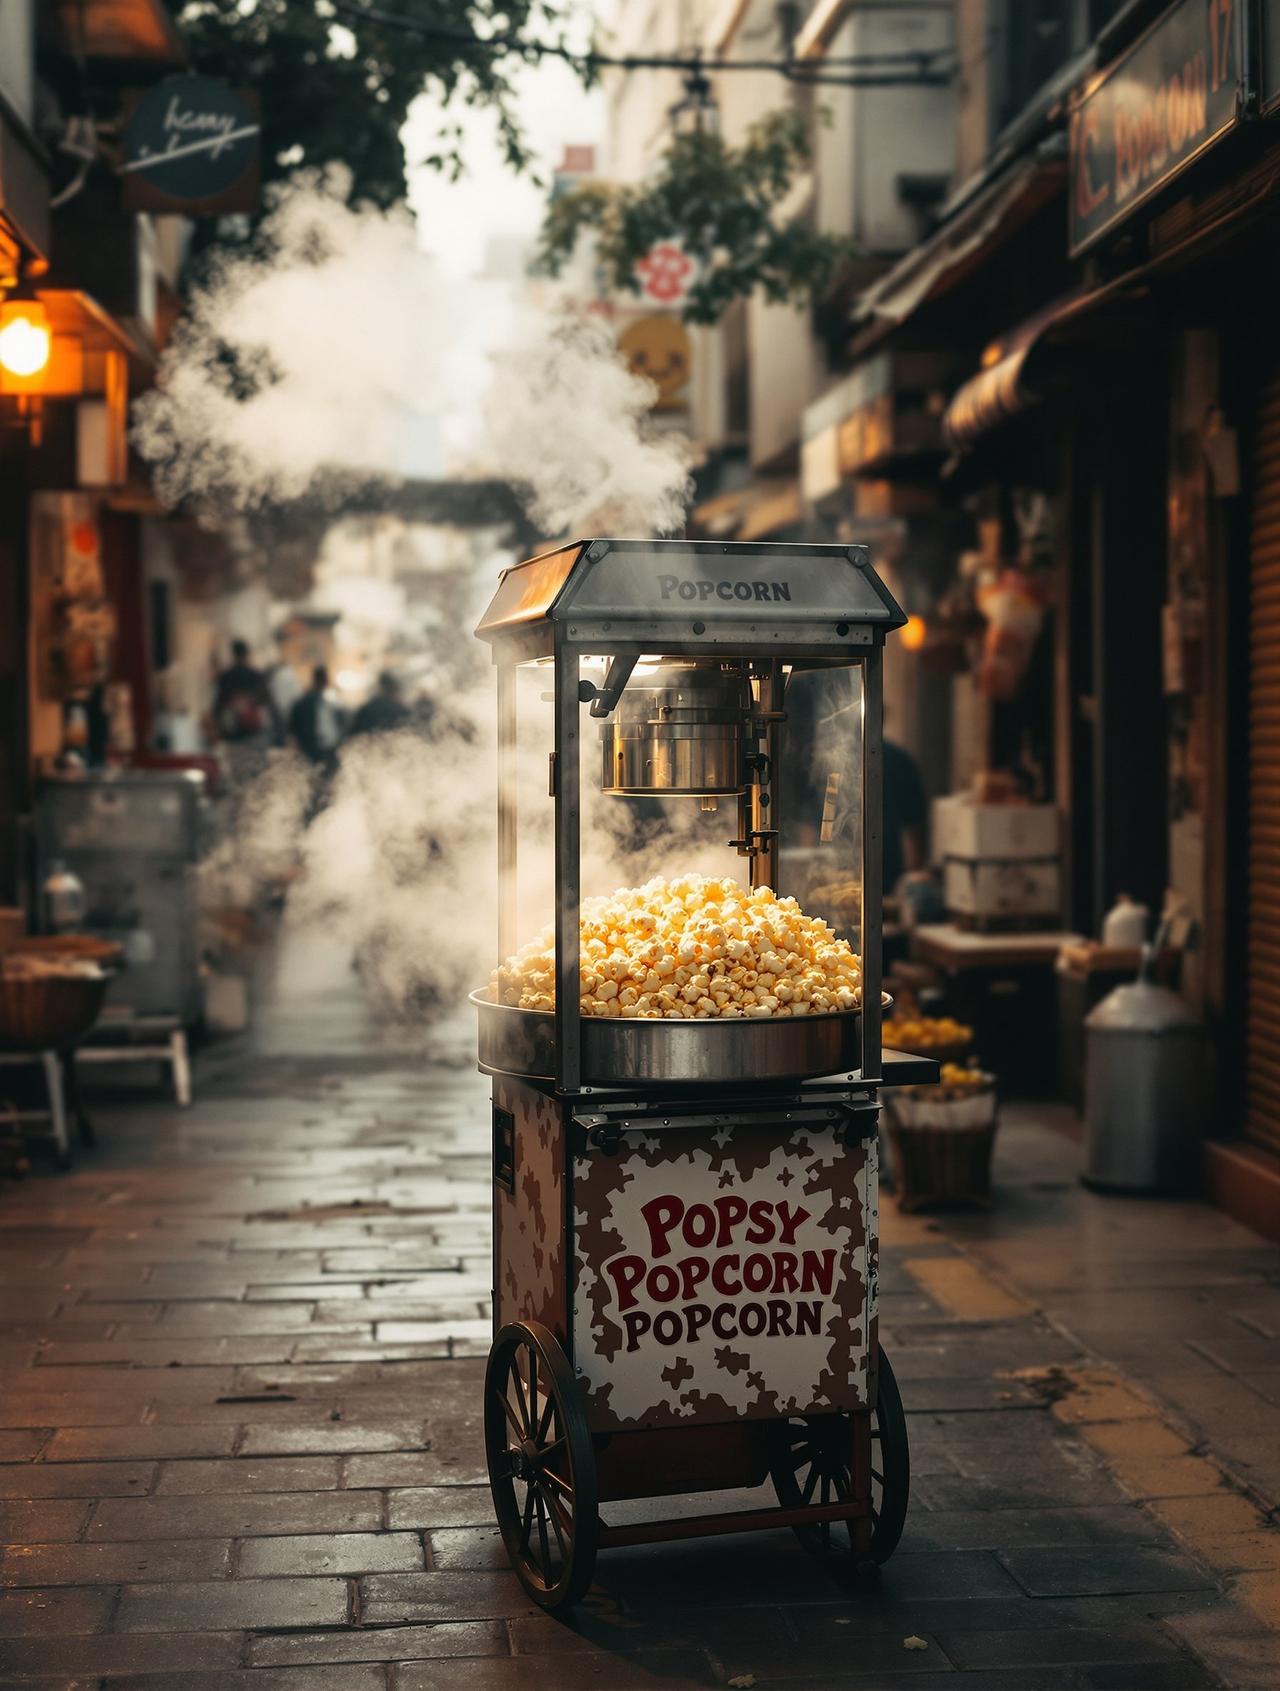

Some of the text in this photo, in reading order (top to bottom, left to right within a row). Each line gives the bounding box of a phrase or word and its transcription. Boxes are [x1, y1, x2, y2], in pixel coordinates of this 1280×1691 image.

[657, 574, 792, 602] POPCORN
[640, 1194, 812, 1259] POPSY
[606, 1249, 838, 1312] POPCORN
[622, 1299, 825, 1353] POPCORN
